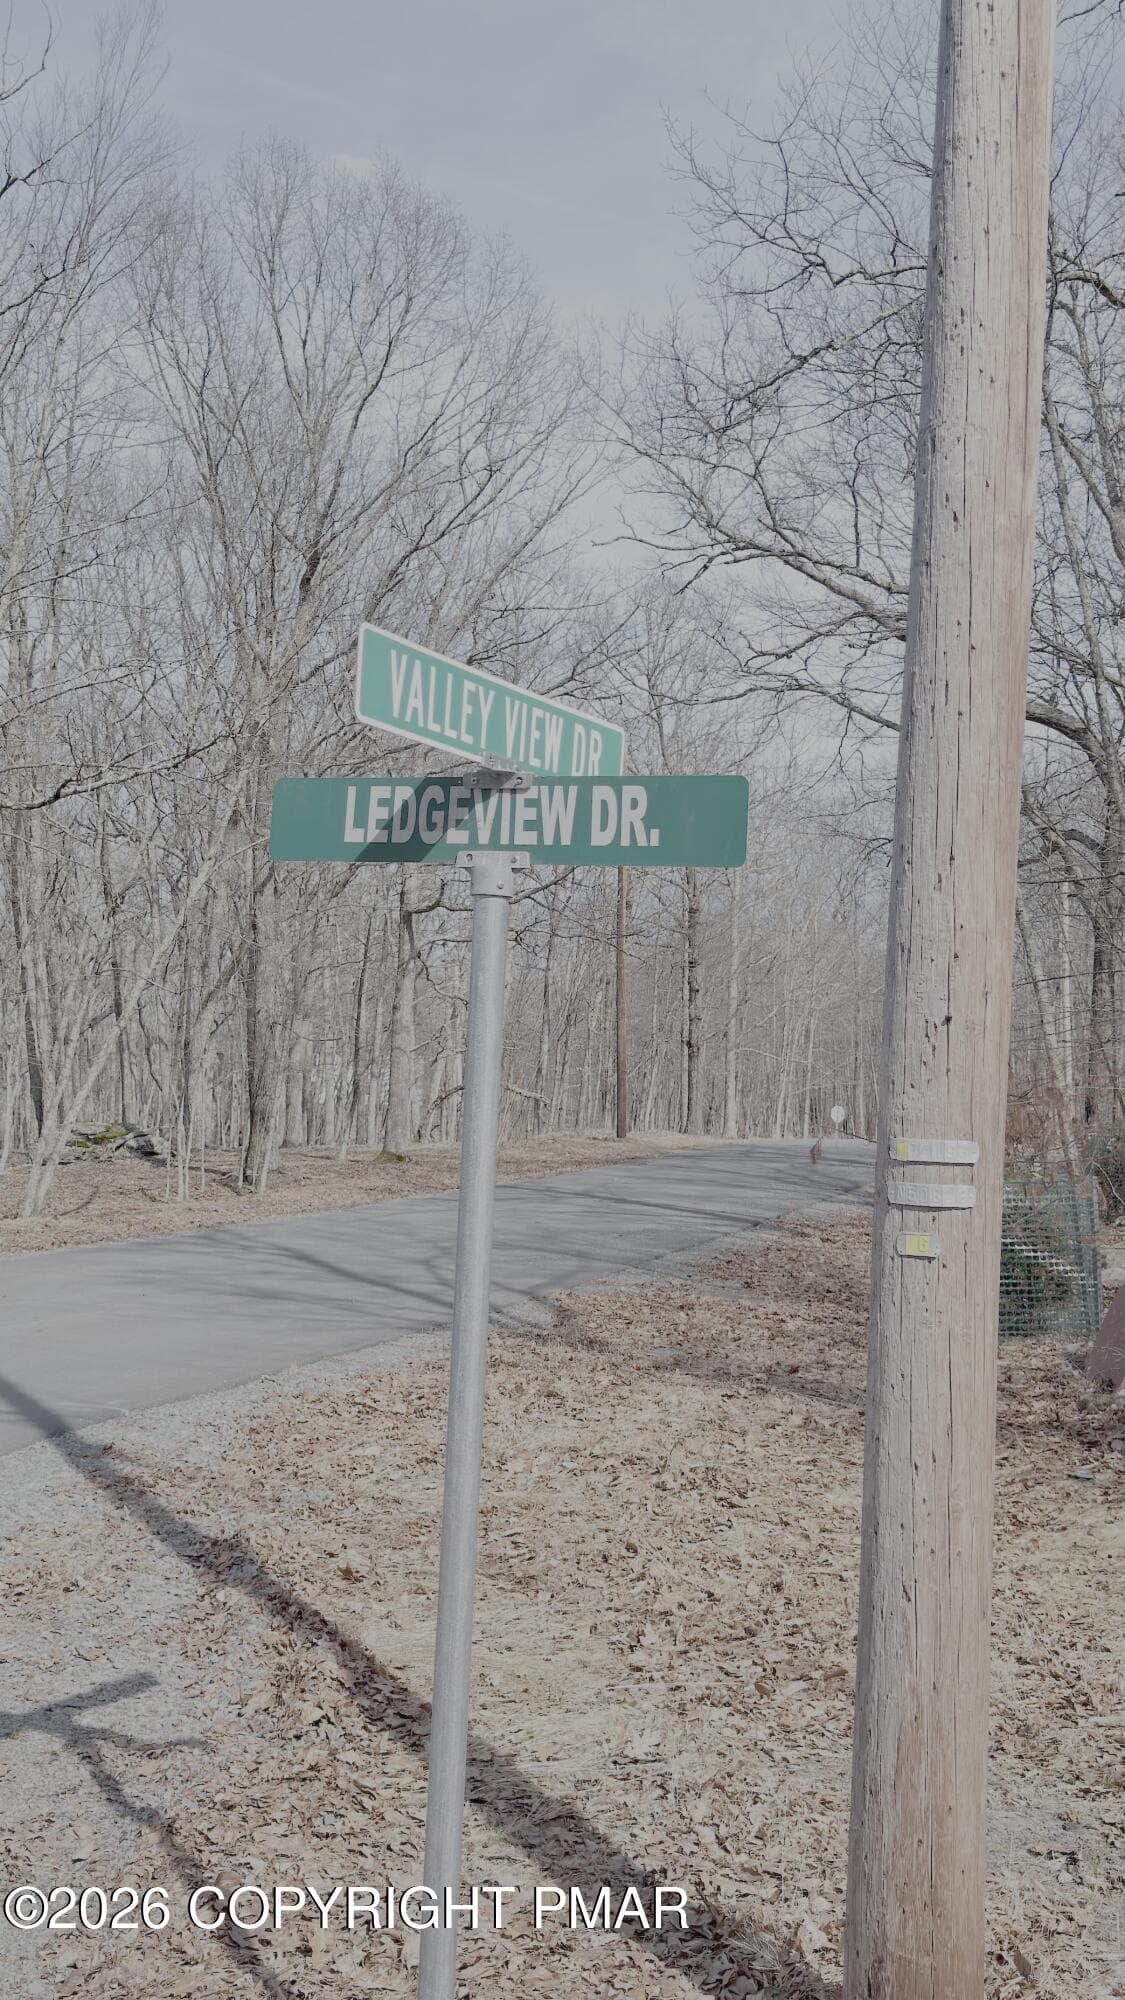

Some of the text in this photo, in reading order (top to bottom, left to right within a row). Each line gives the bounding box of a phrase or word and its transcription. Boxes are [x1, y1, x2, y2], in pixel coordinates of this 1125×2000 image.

[389, 649, 603, 776] VALLEY VIEW DR
[343, 786, 660, 847] LEDGEVIEW DR.
